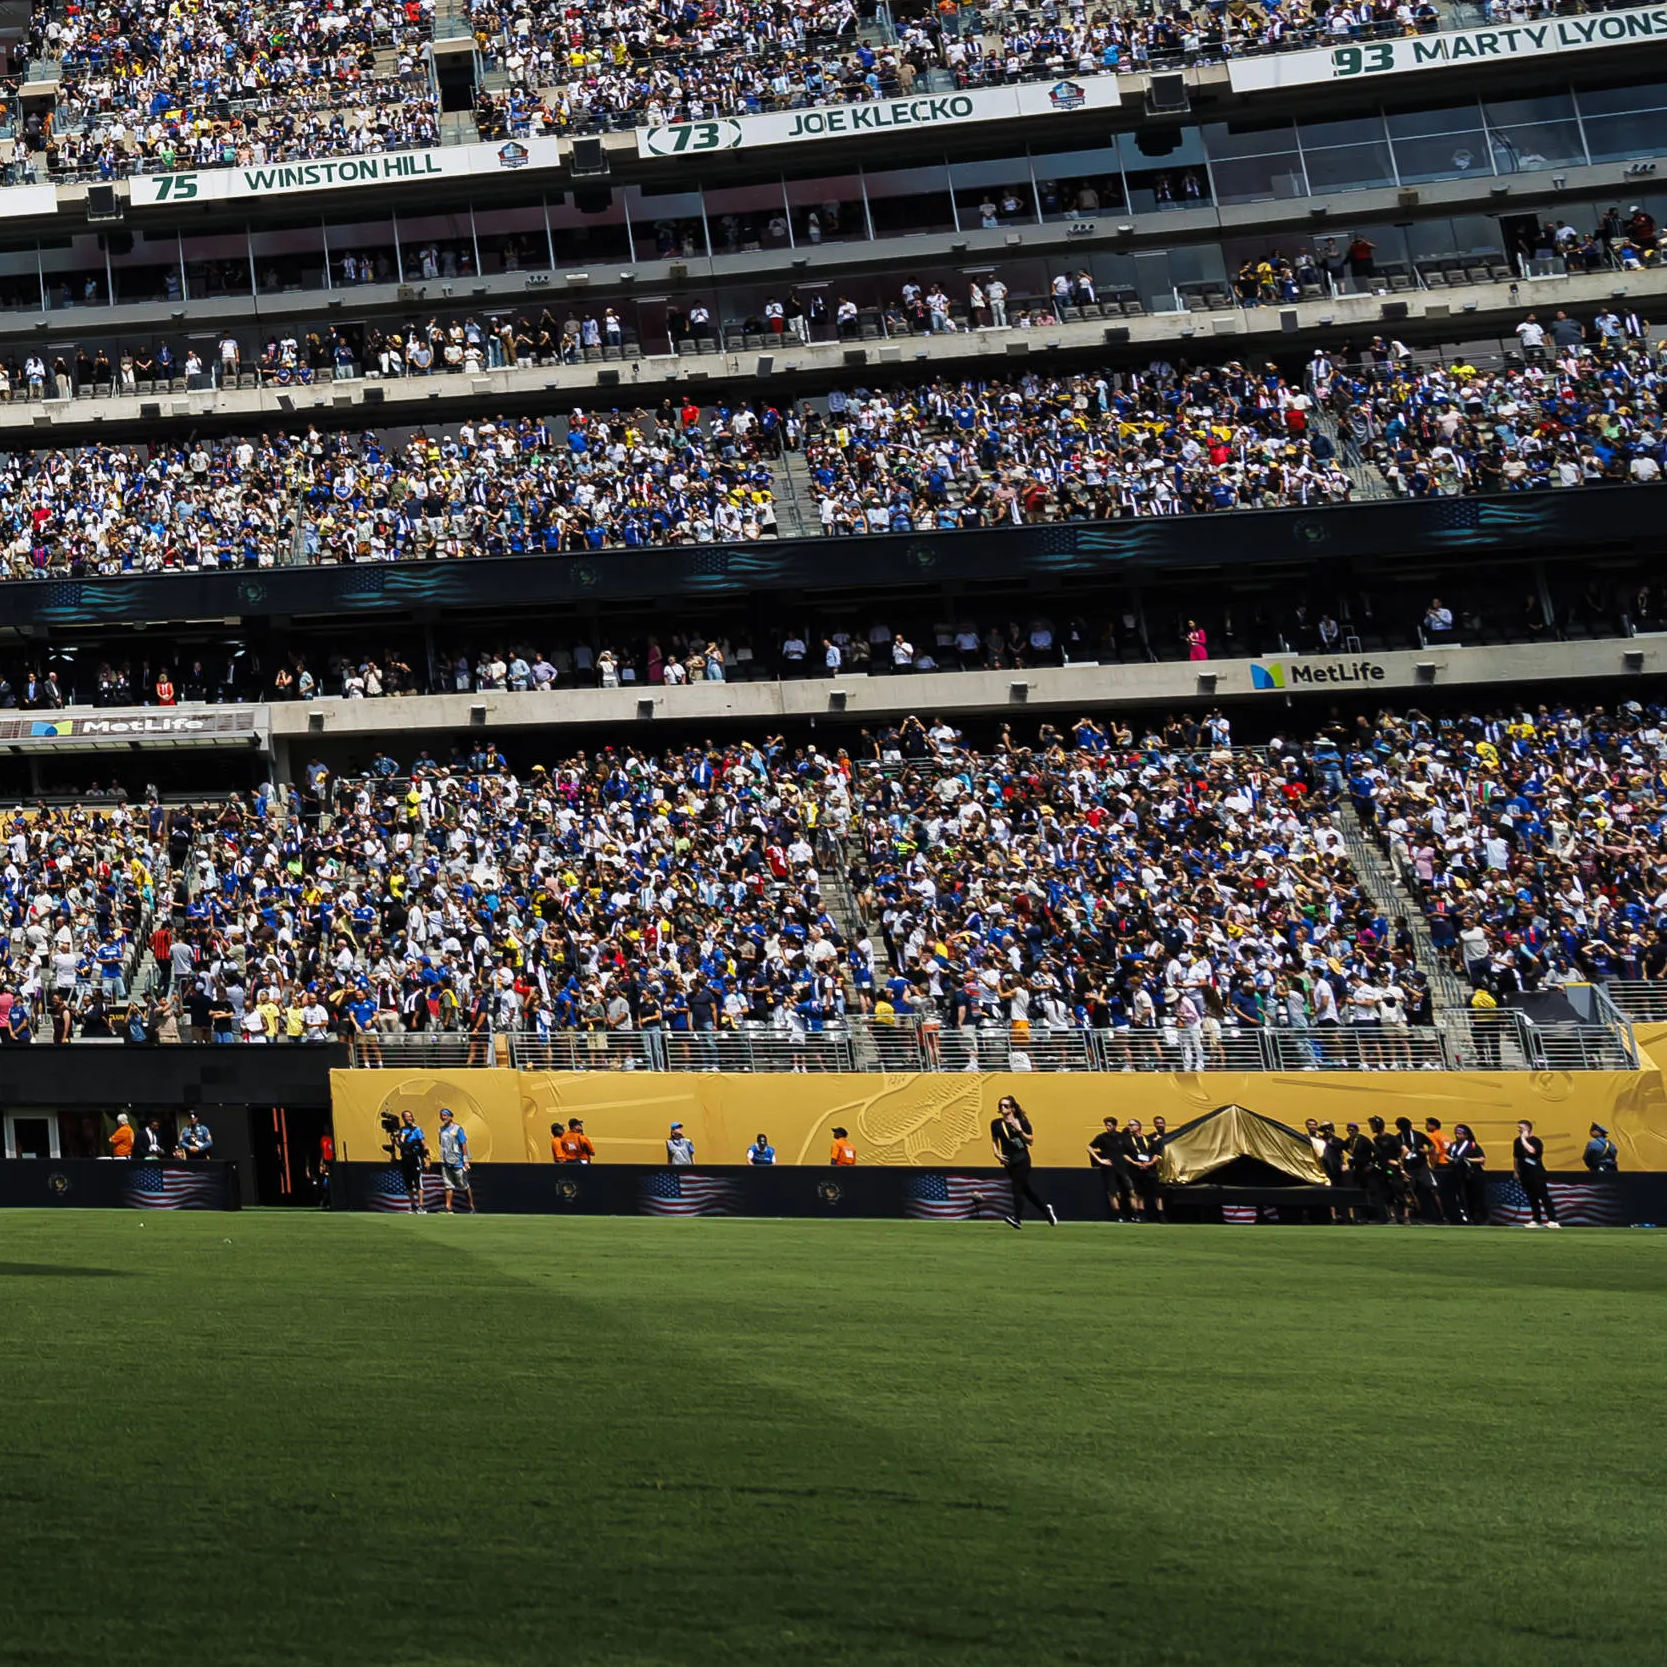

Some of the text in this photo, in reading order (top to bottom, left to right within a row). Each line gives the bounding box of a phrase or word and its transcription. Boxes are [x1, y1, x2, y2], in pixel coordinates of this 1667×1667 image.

[1332, 11, 1667, 76] 93 MARTY LYONS
[668, 95, 973, 151] 73 JOE KLECKO
[152, 154, 442, 201] 75 WINSTON HILL
[1291, 662, 1385, 684] MetLife
[83, 717, 204, 734] MetLife
